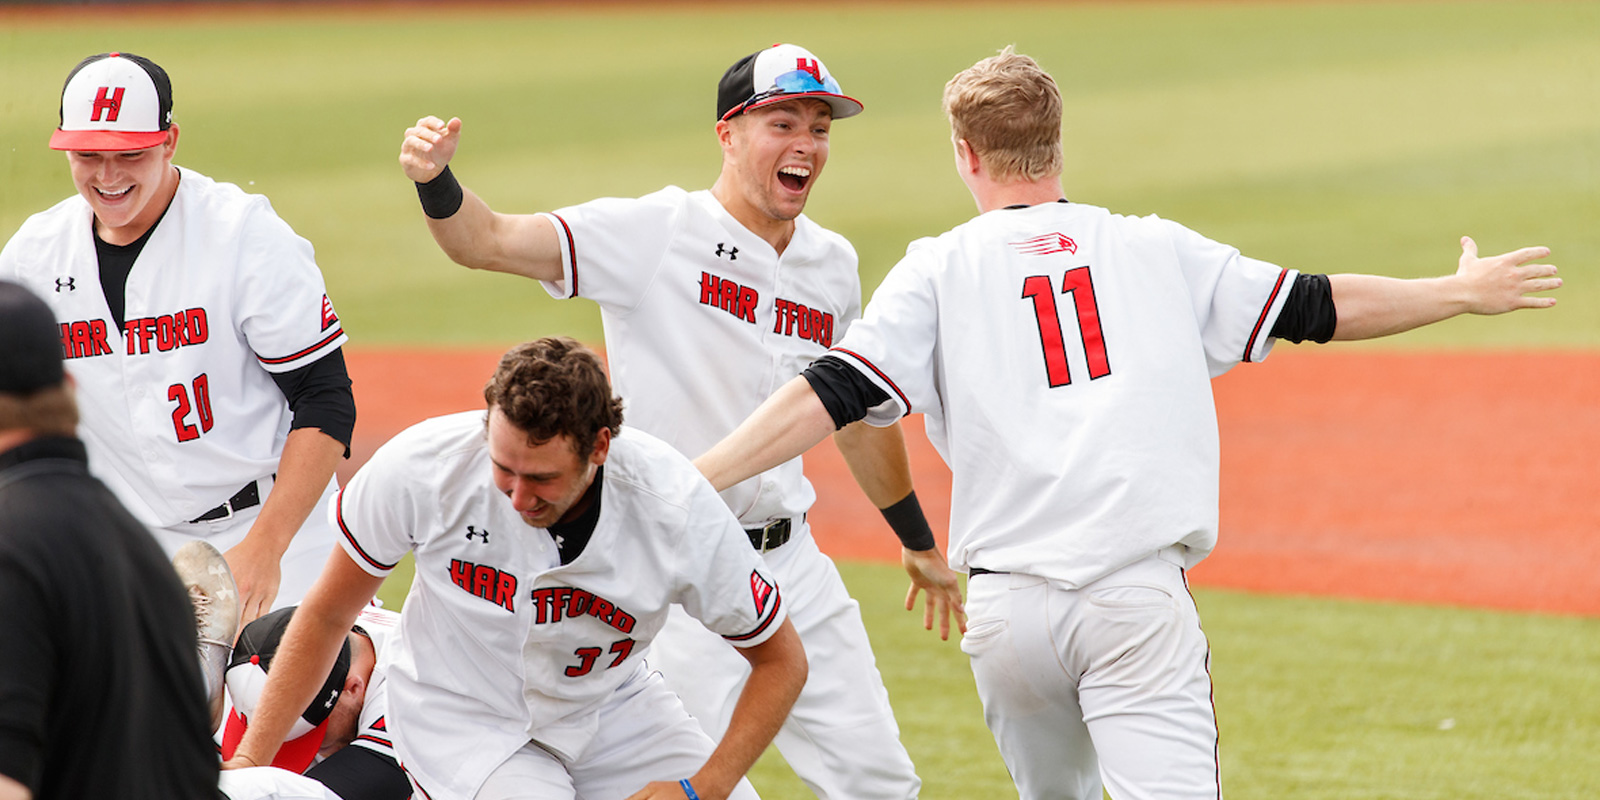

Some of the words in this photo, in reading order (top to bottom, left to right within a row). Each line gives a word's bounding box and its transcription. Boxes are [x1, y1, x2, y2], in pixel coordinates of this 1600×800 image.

[90, 86, 126, 122] H
[1021, 265, 1111, 389] 11
[168, 372, 214, 443] 20
